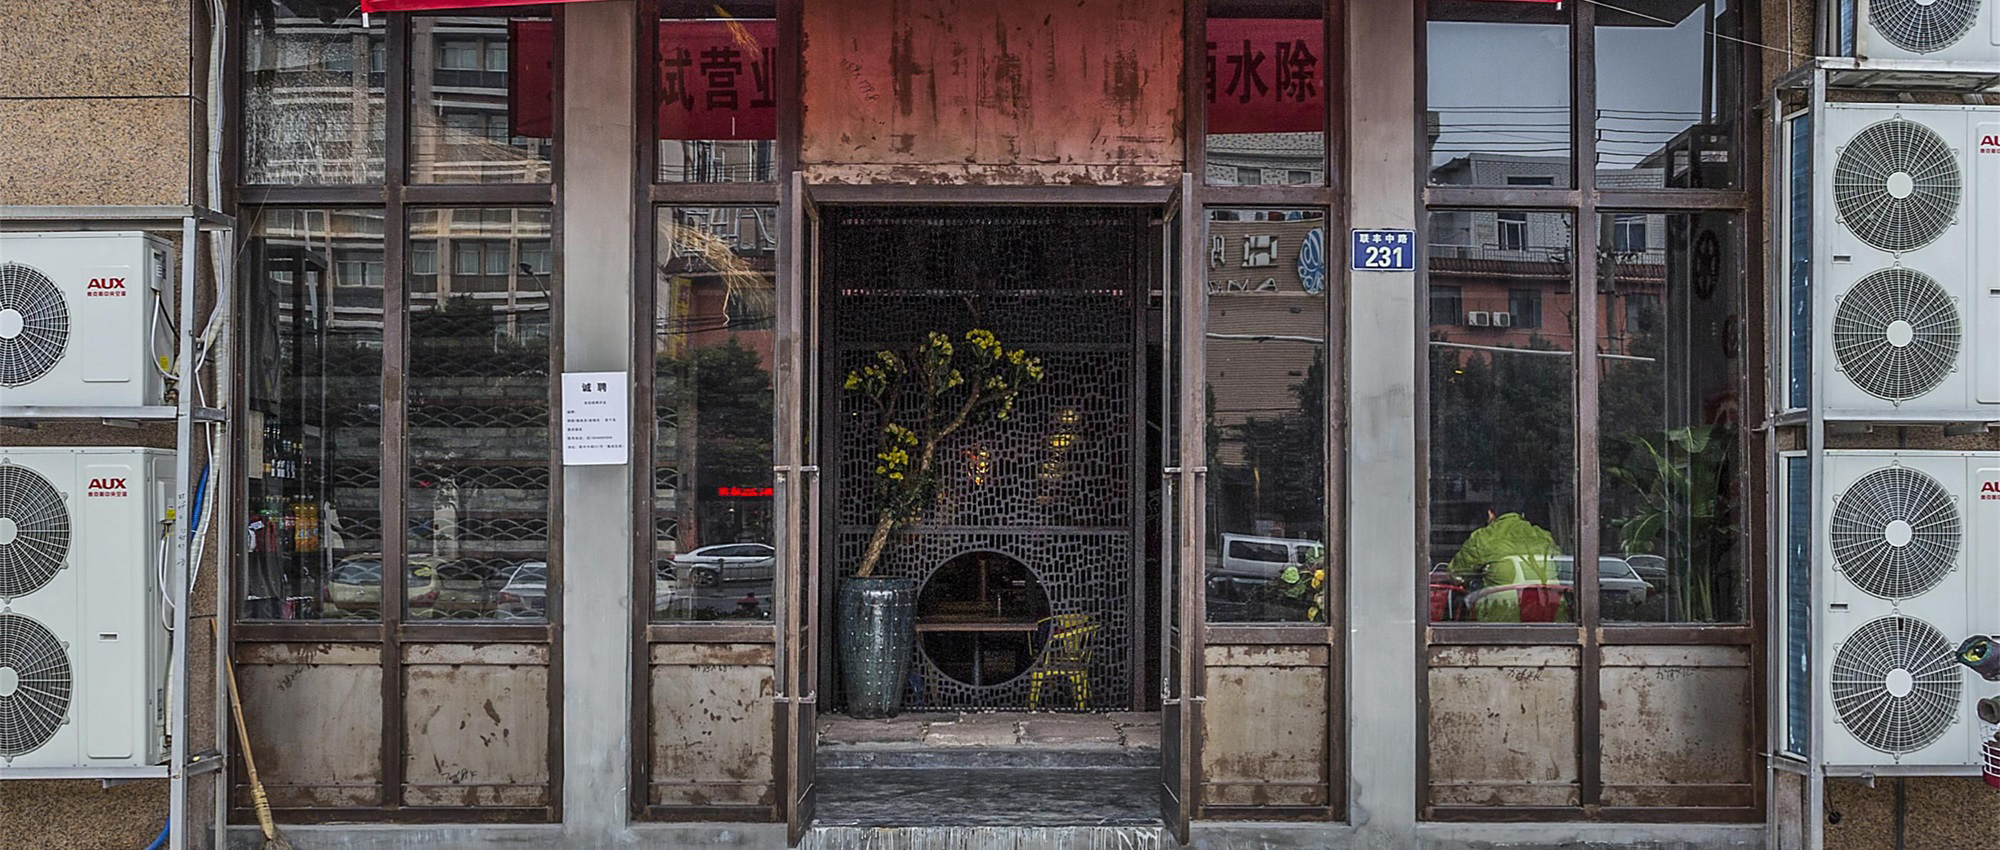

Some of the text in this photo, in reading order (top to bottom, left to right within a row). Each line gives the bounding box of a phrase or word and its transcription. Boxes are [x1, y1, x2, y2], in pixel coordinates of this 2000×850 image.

[1365, 246, 1403, 268] 231
[87, 277, 126, 290] AUX
[88, 477, 127, 490] AUX
